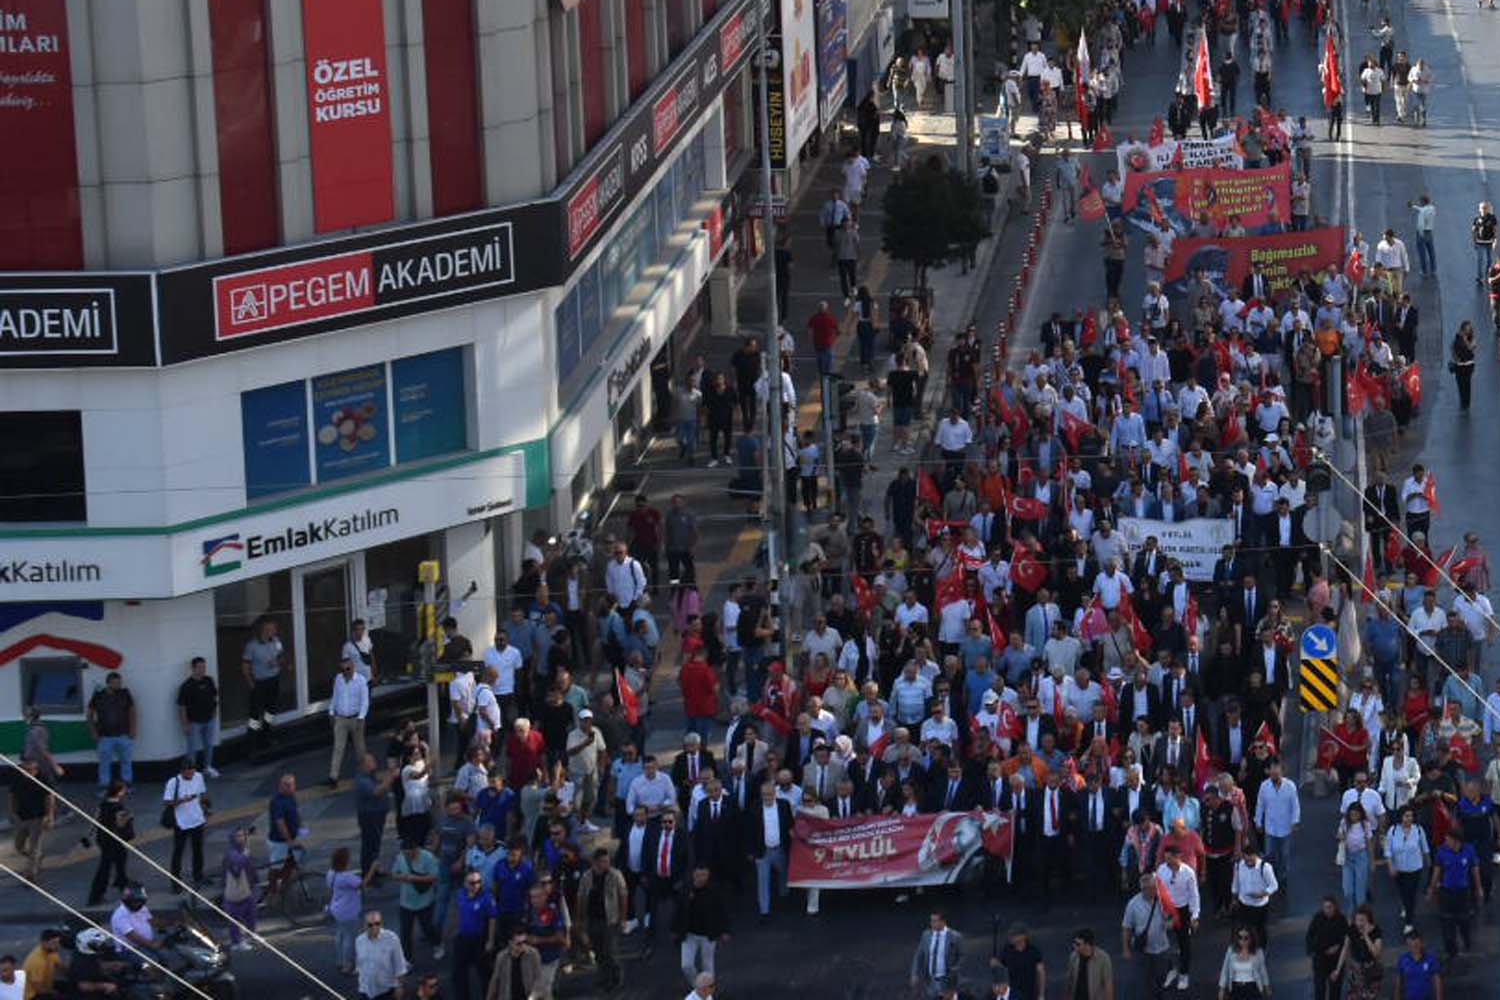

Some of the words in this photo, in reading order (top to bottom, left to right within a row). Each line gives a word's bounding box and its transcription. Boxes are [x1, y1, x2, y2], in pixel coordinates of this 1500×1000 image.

[0, 35, 59, 52] LARI
[314, 58, 379, 83] ÖZEL
[315, 83, 380, 102] ÖĞRETİM
[316, 99, 381, 122] KURSU
[269, 268, 371, 313] PEGEM
[378, 236, 502, 293] AKADEMİ
[0, 302, 101, 338] ADEMİ
